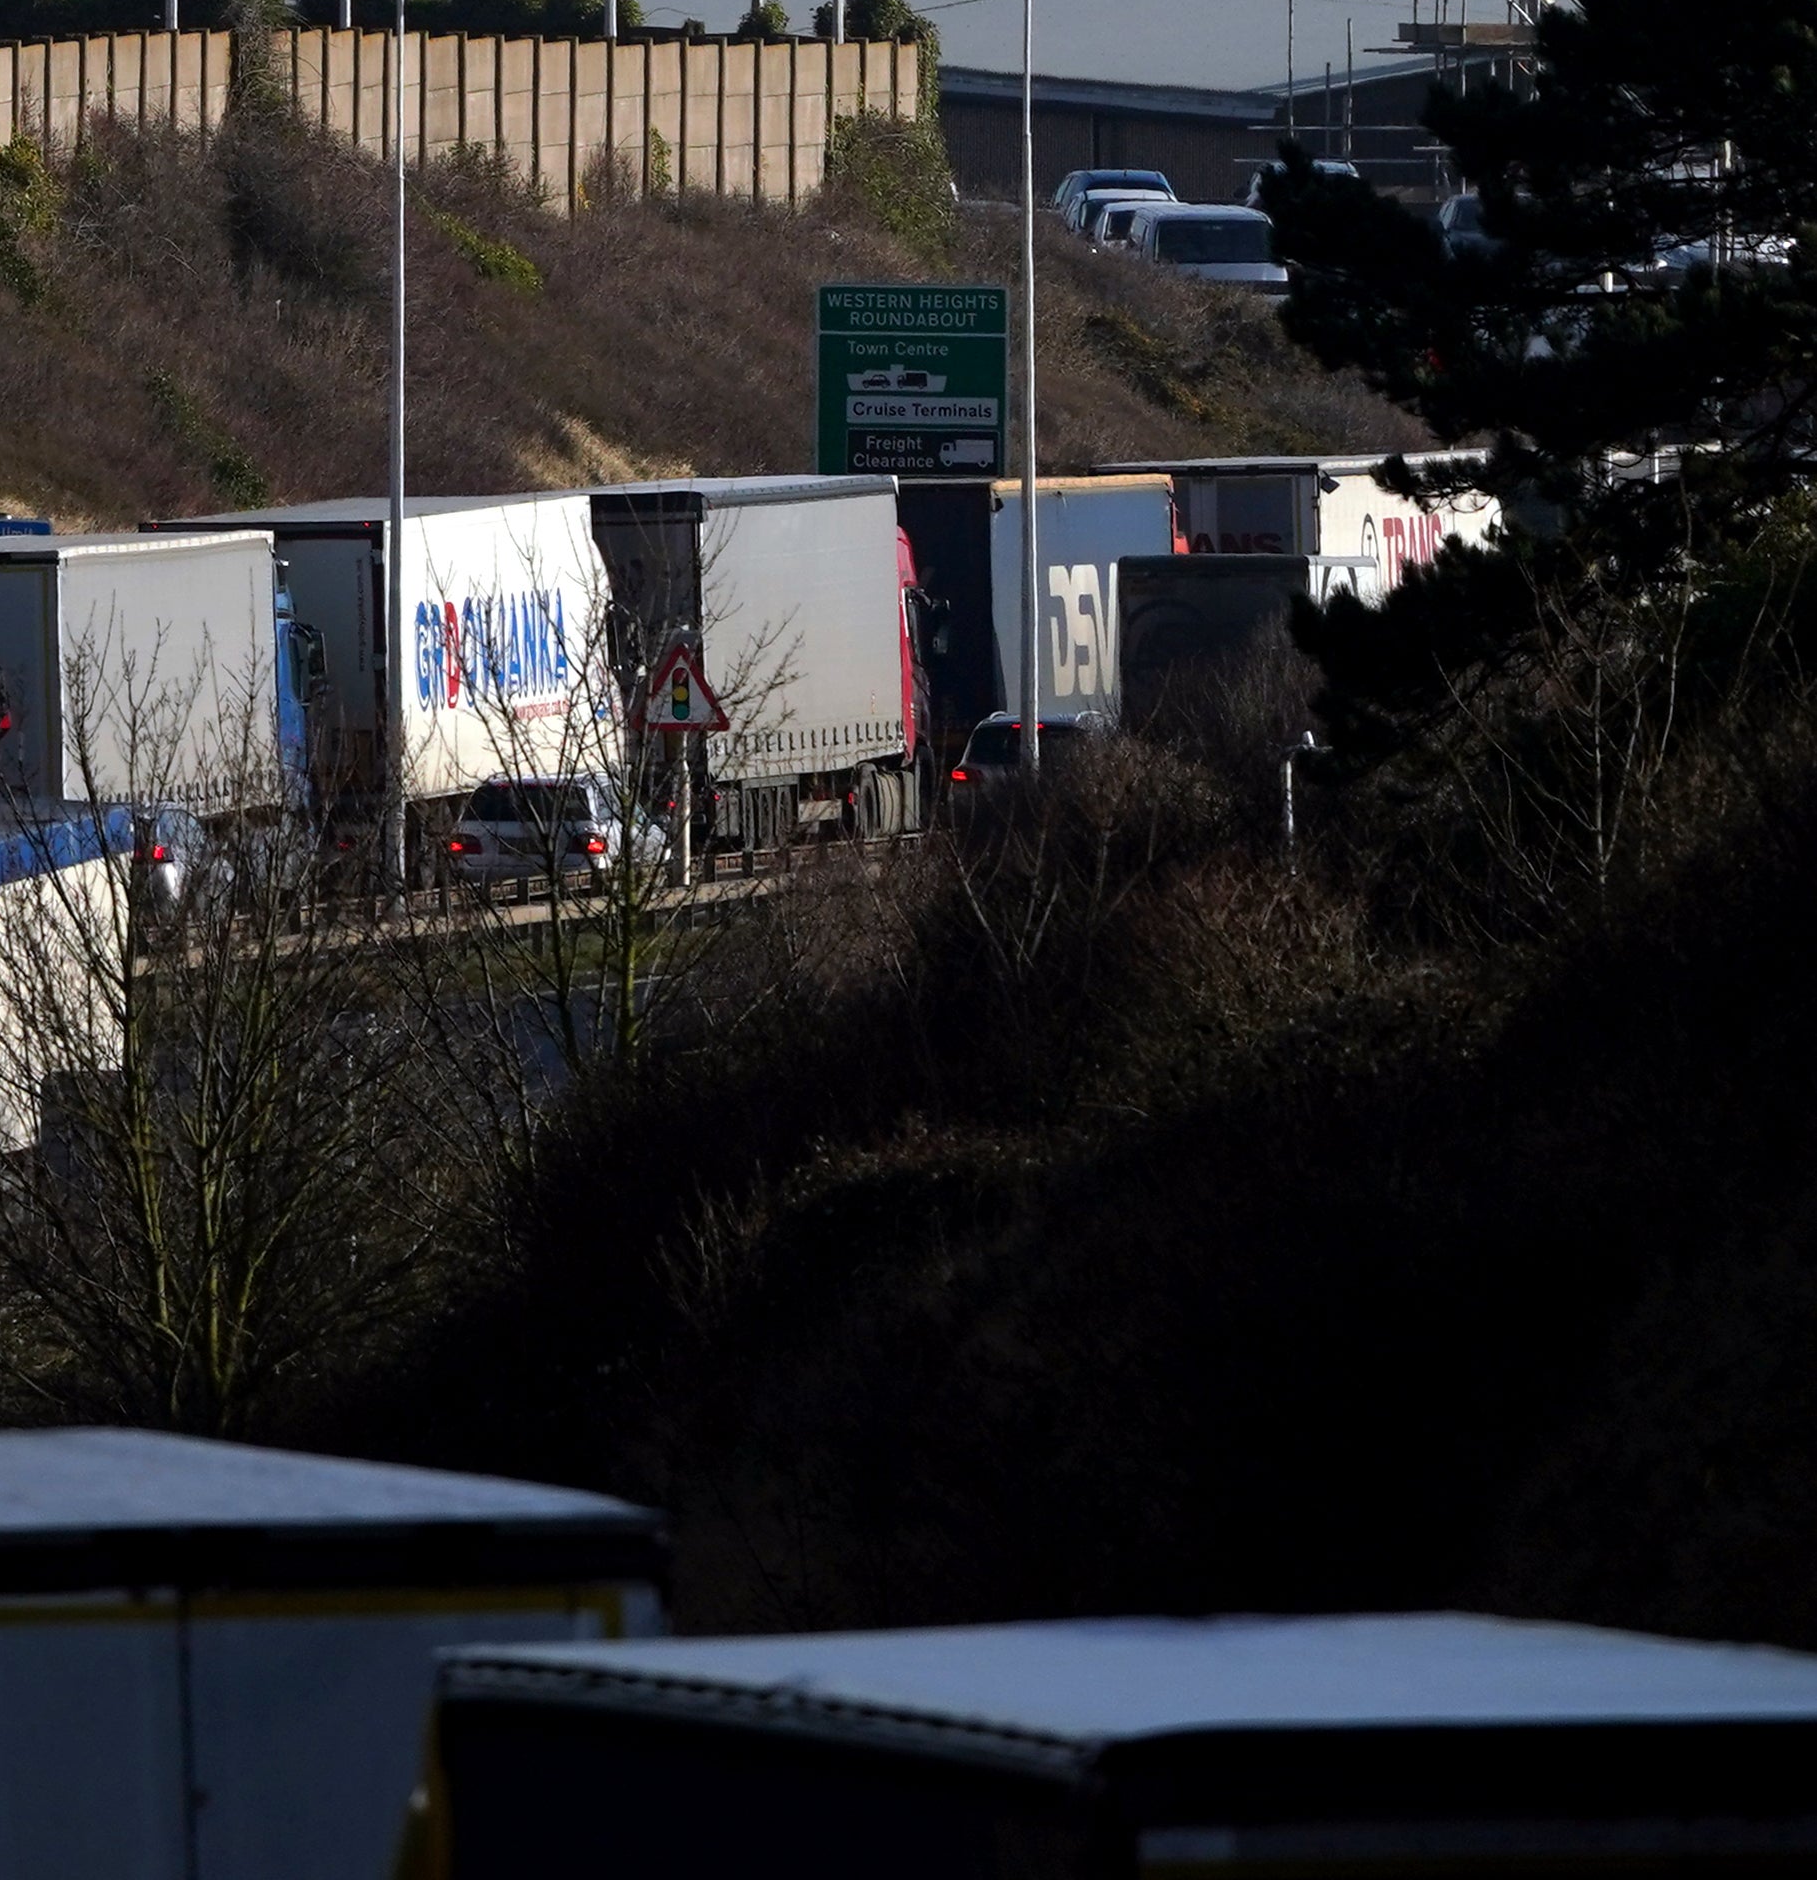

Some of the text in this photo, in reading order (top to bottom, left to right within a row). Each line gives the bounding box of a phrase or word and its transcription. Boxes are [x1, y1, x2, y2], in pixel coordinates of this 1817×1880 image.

[827, 293, 999, 310] WESTERN HEIGHTS
[850, 311, 977, 327] ROUNDABOUT
[847, 340, 949, 356] Town Centre
[853, 401, 992, 418] Cruise Terminals
[866, 436, 923, 452] Freight
[853, 453, 935, 468] Clearance
[1049, 562, 1118, 697] DSV
